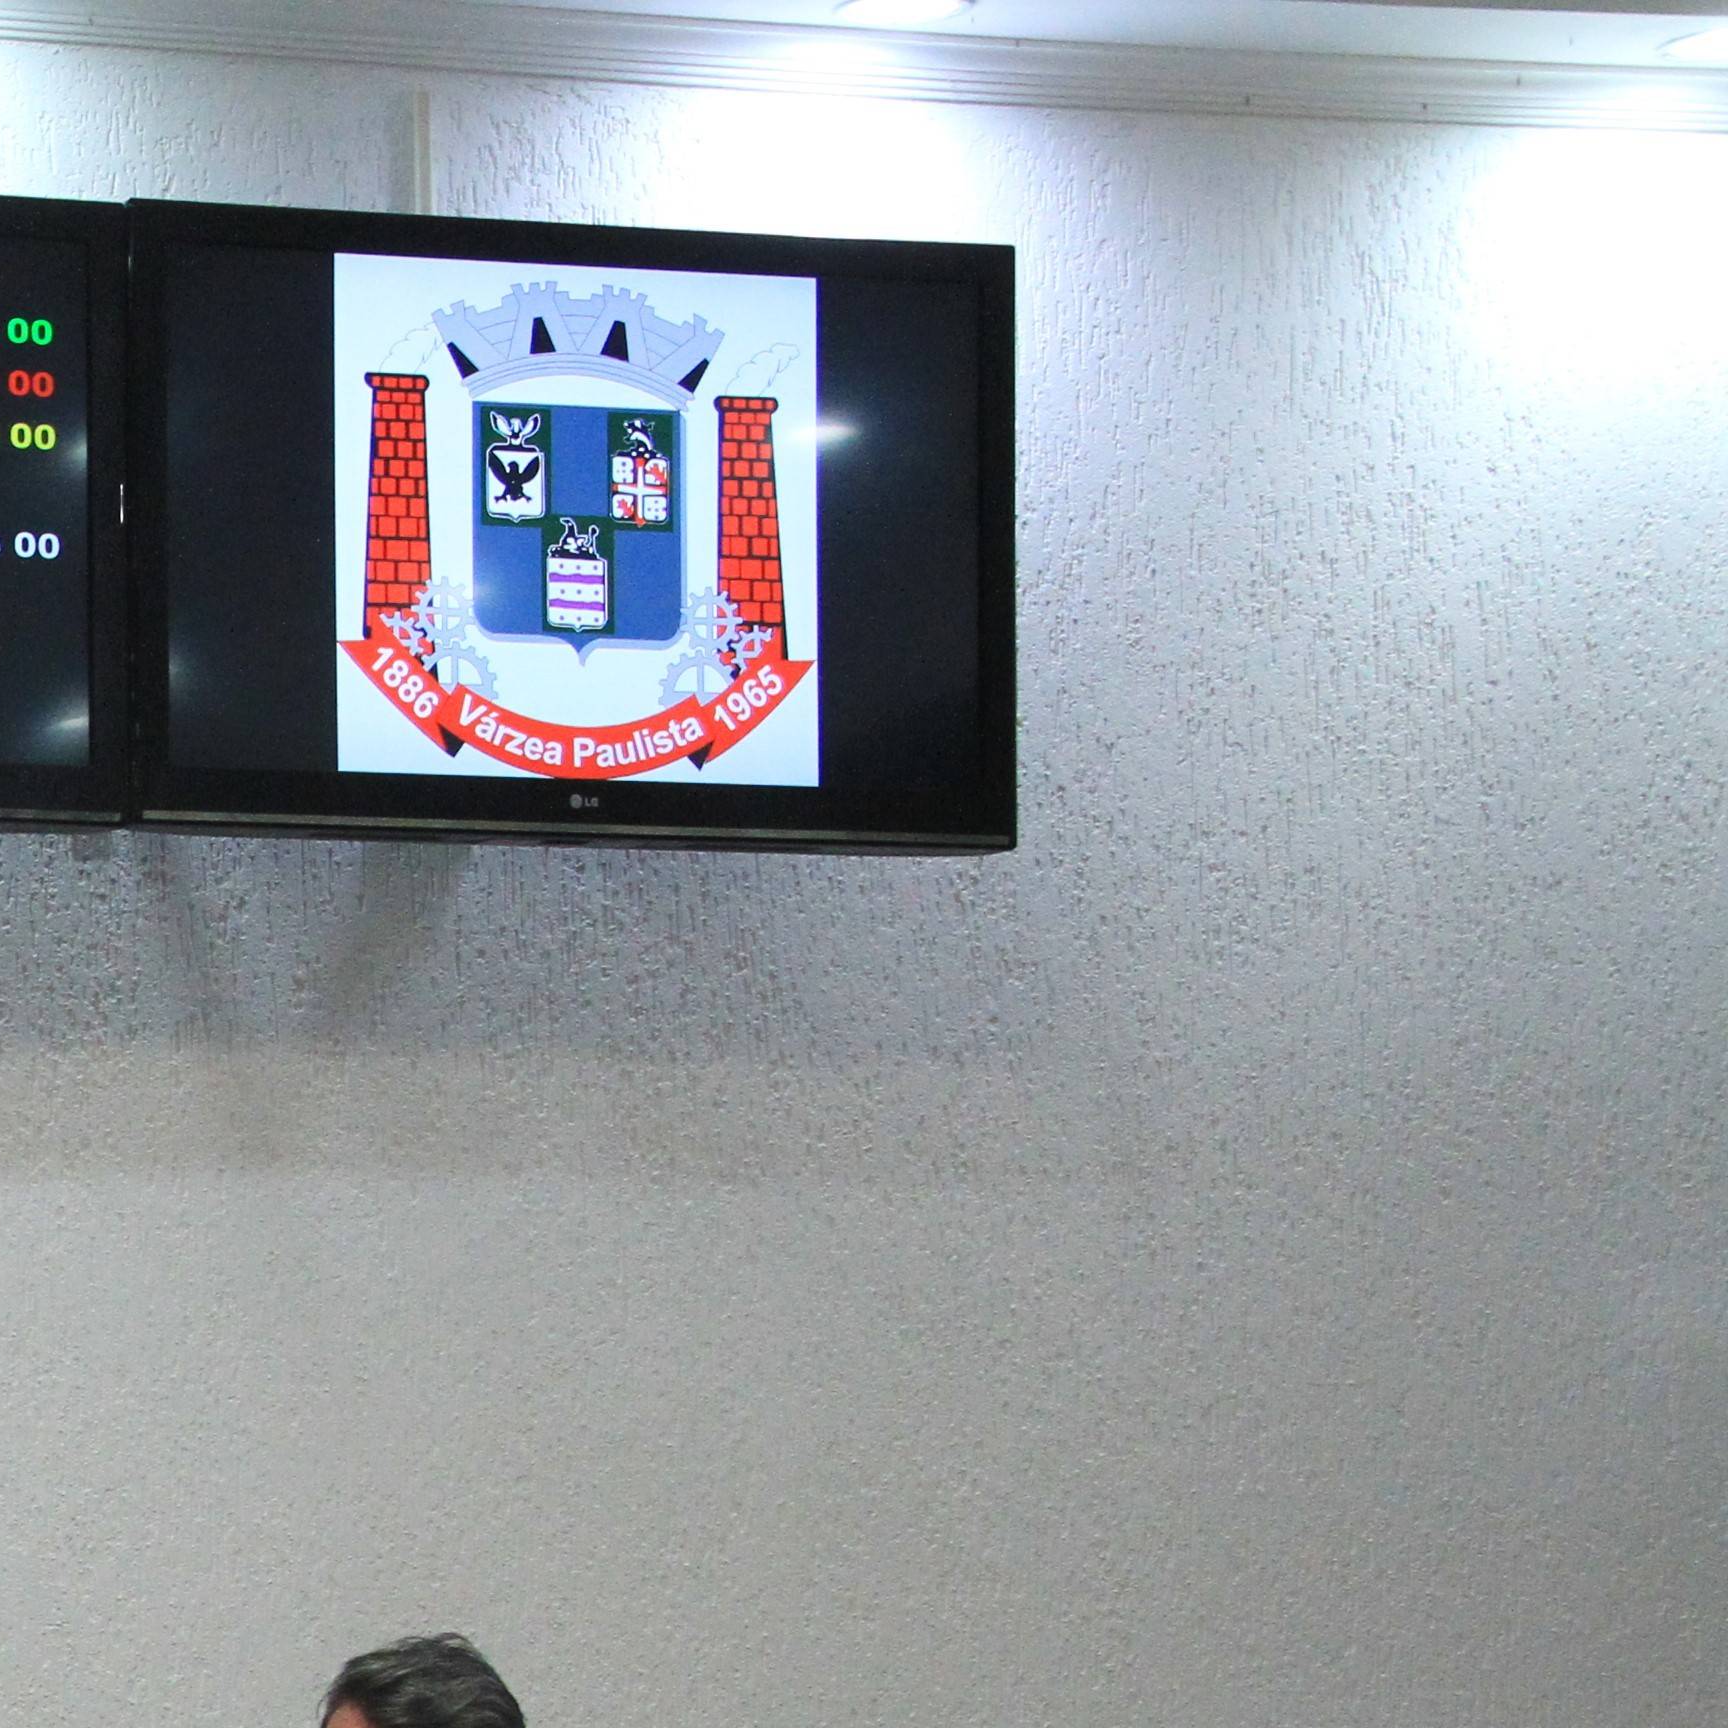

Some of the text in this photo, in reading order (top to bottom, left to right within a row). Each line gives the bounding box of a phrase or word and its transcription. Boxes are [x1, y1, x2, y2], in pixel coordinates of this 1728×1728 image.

[7, 317, 54, 346] 00
[7, 369, 55, 398] 00
[9, 422, 57, 451] 00
[14, 531, 61, 560] 00
[370, 646, 784, 768] 1886 Várzea Paulista 1965
[584, 796, 600, 808] LG
